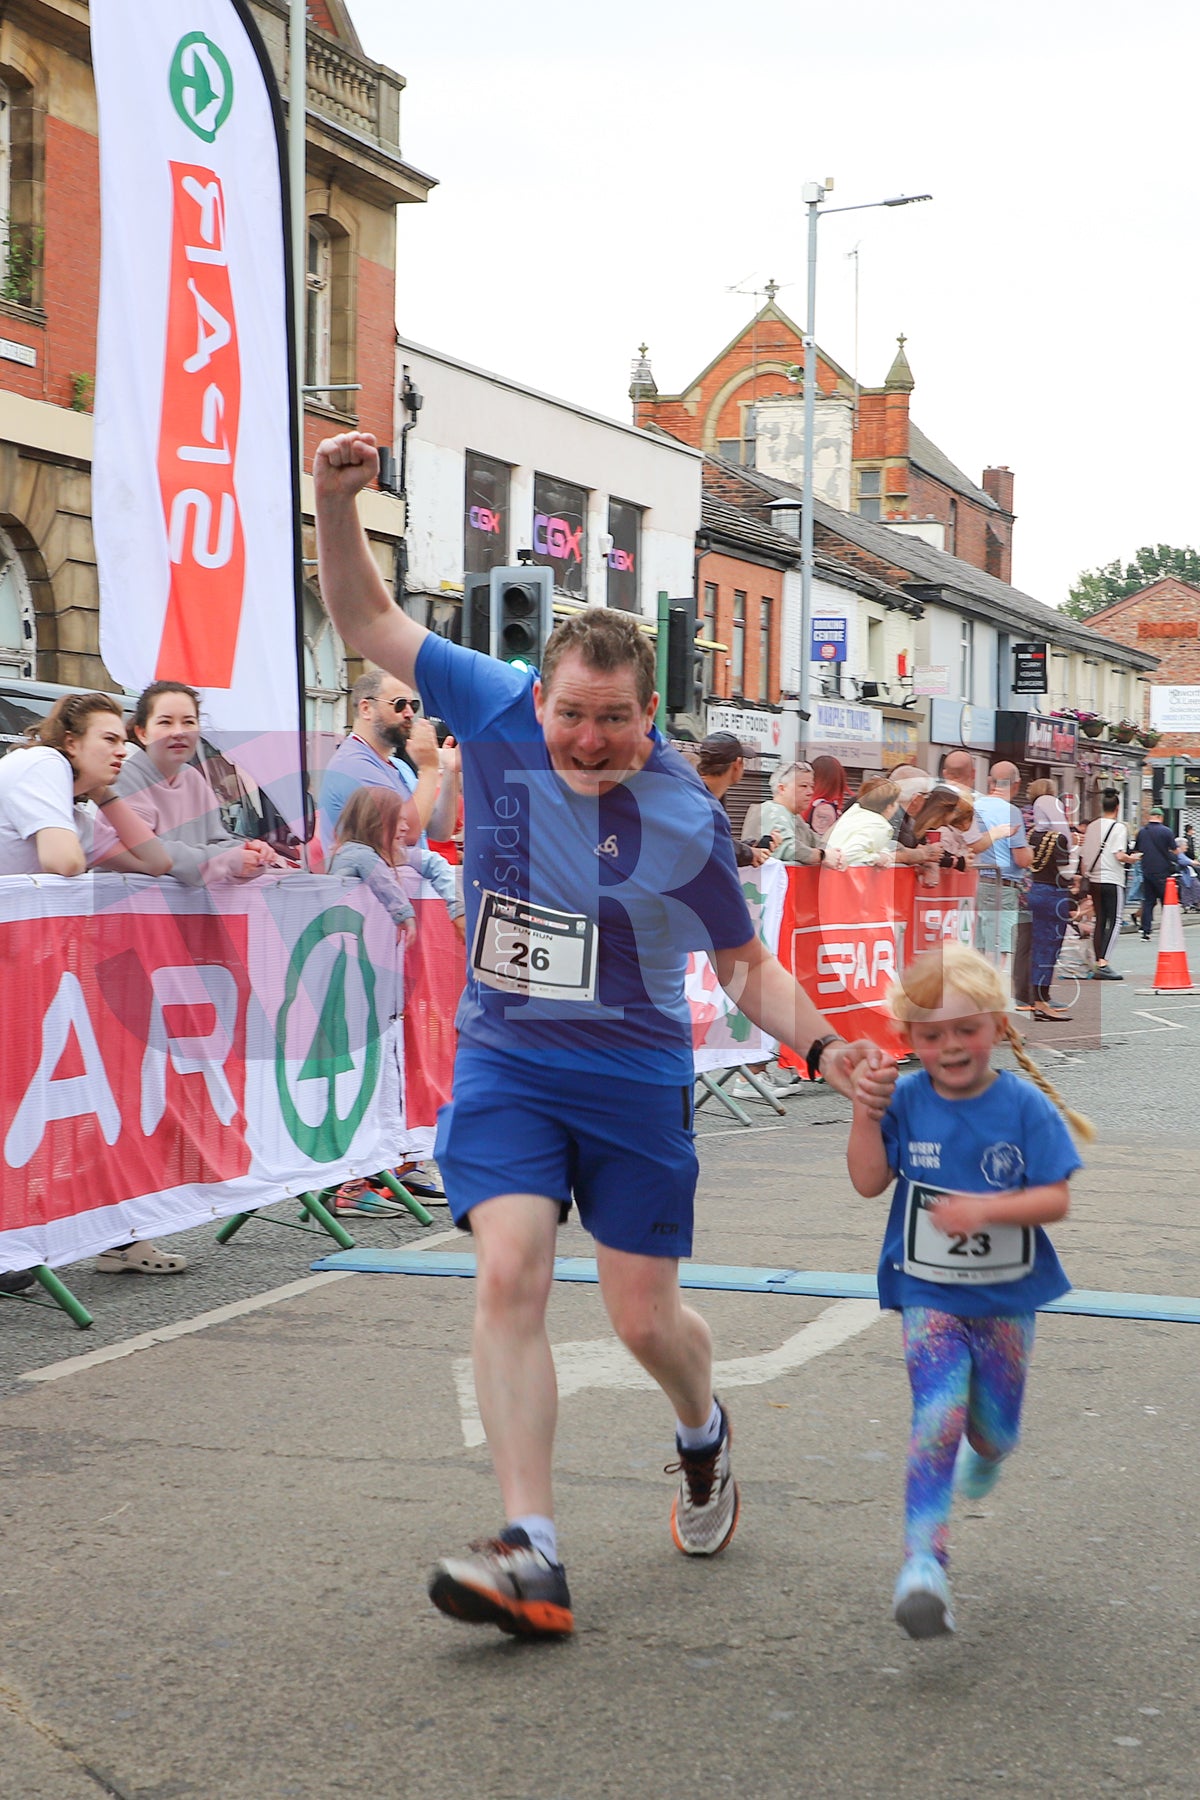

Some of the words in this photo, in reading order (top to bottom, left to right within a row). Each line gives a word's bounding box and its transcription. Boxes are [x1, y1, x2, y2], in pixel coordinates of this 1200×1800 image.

[469, 505, 500, 534] CGX
[533, 514, 583, 563] CGX
[608, 548, 635, 573] CGX
[711, 711, 729, 728] HYDE
[731, 713, 743, 730] PET
[745, 714, 768, 733] FOODS
[513, 926, 531, 936] FUN
[532, 931, 553, 941] RUN
[510, 942, 550, 971] 26
[816, 939, 900, 995] SPAR
[947, 1231, 992, 1257] 23
